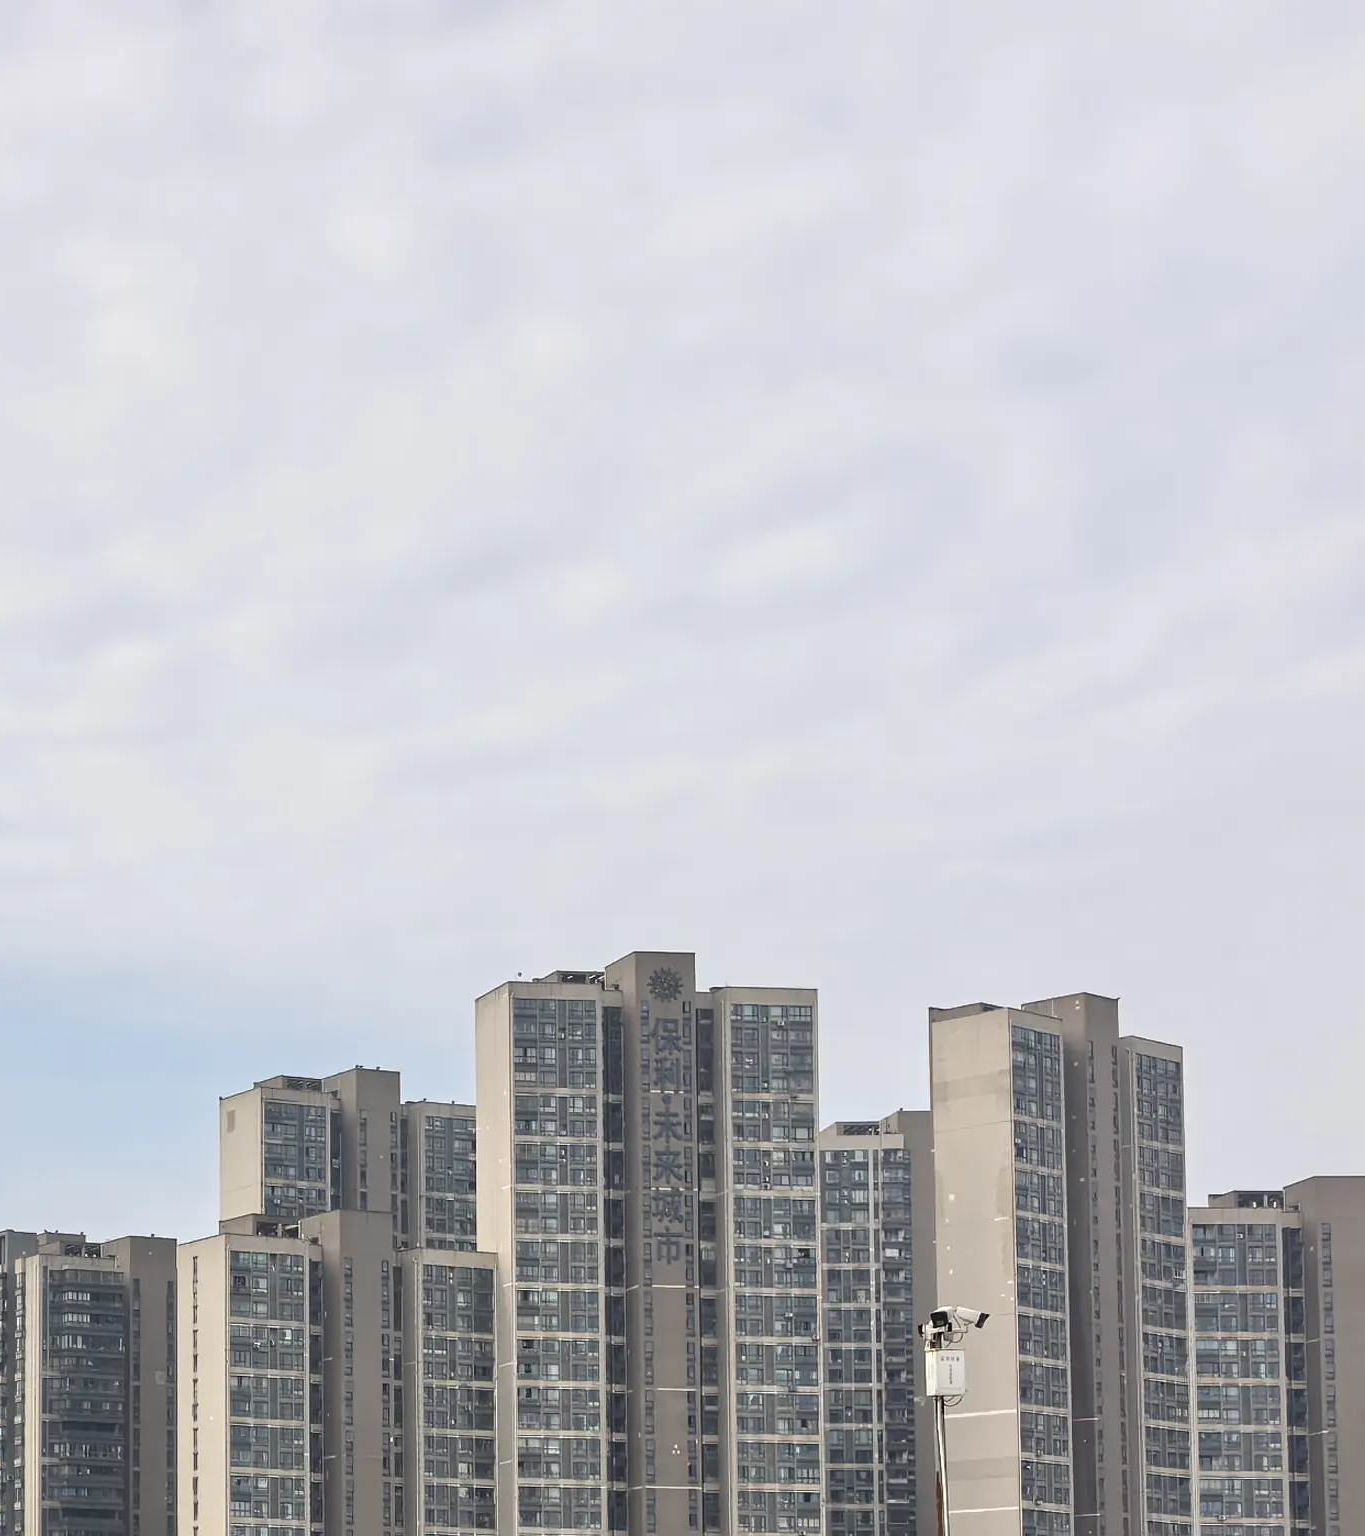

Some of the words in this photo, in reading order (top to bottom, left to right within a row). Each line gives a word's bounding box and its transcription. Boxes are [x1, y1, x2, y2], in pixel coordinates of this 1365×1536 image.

[651, 1017, 684, 1265] 保利·未来城市
